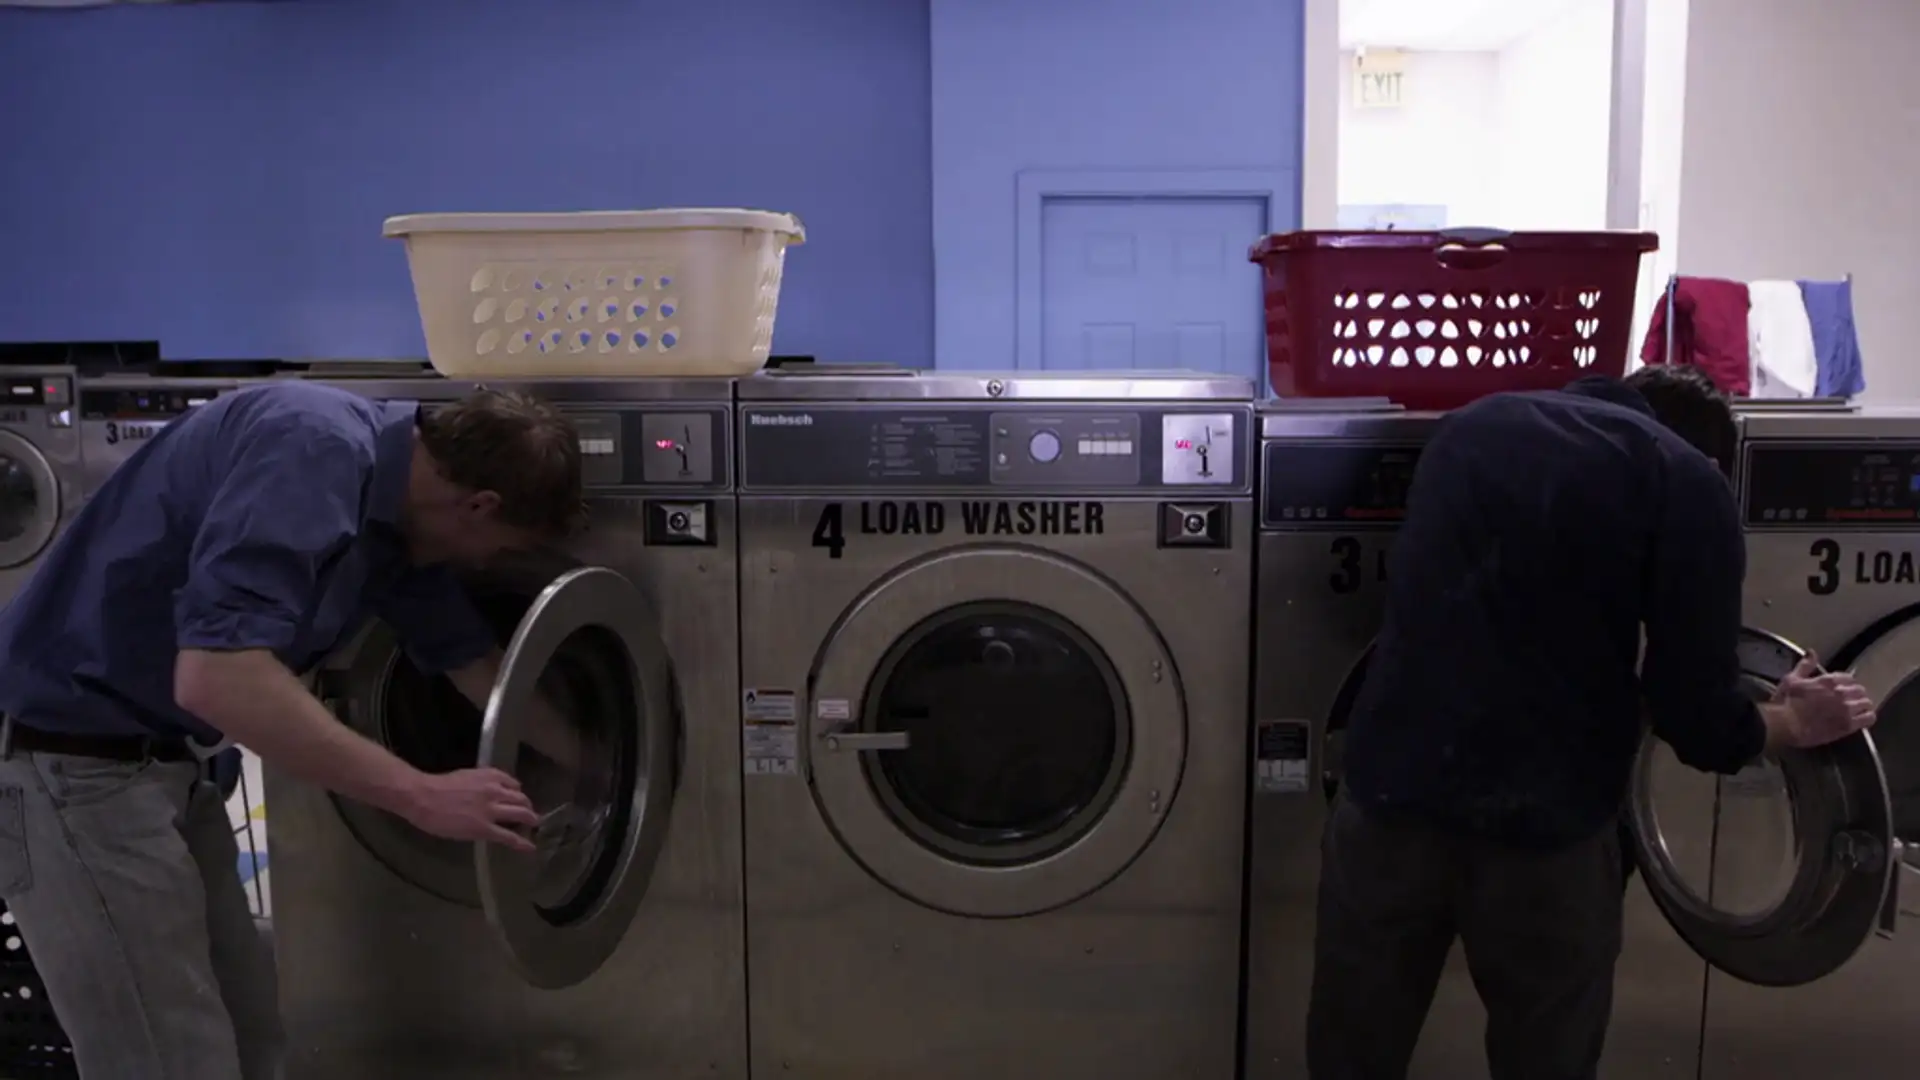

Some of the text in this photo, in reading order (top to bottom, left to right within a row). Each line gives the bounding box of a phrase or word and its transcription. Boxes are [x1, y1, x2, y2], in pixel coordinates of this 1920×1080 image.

[1361, 71, 1403, 103] EXIT
[106, 421, 119, 445] 3
[812, 501, 1105, 559] 4 LOAD WASHER
[1330, 537, 1362, 594] 3
[1808, 538, 1920, 596] 3 LOA
